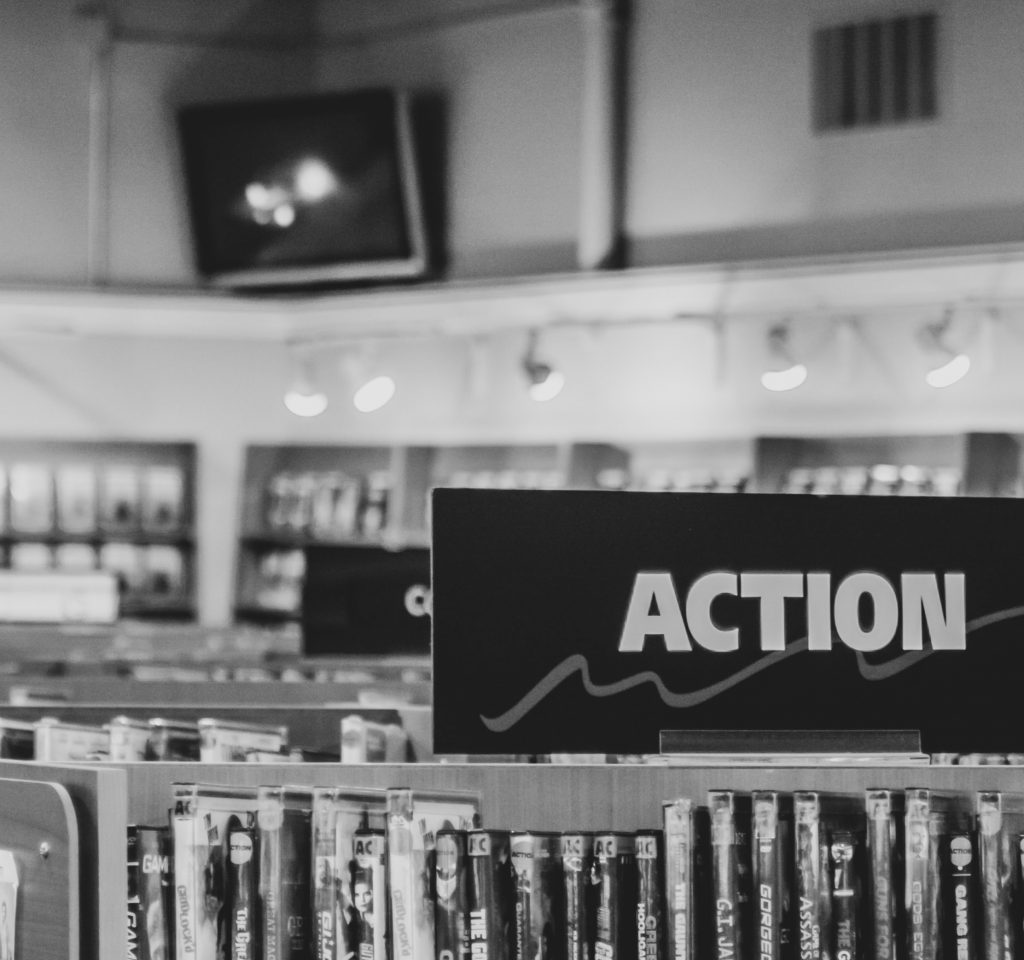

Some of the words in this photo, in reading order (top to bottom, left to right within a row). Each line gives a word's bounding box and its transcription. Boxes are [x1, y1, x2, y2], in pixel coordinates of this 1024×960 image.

[619, 572, 967, 653] ACTION
[674, 883, 686, 911] THE
[875, 876, 889, 921] GUNS
[912, 881, 923, 925] GODS
[955, 884, 969, 936] GANG
[235, 907, 248, 931] THE
[470, 908, 488, 939] THE
[716, 899, 731, 933] G.I.
[837, 919, 851, 949] THE
[877, 925, 890, 959] FOR
